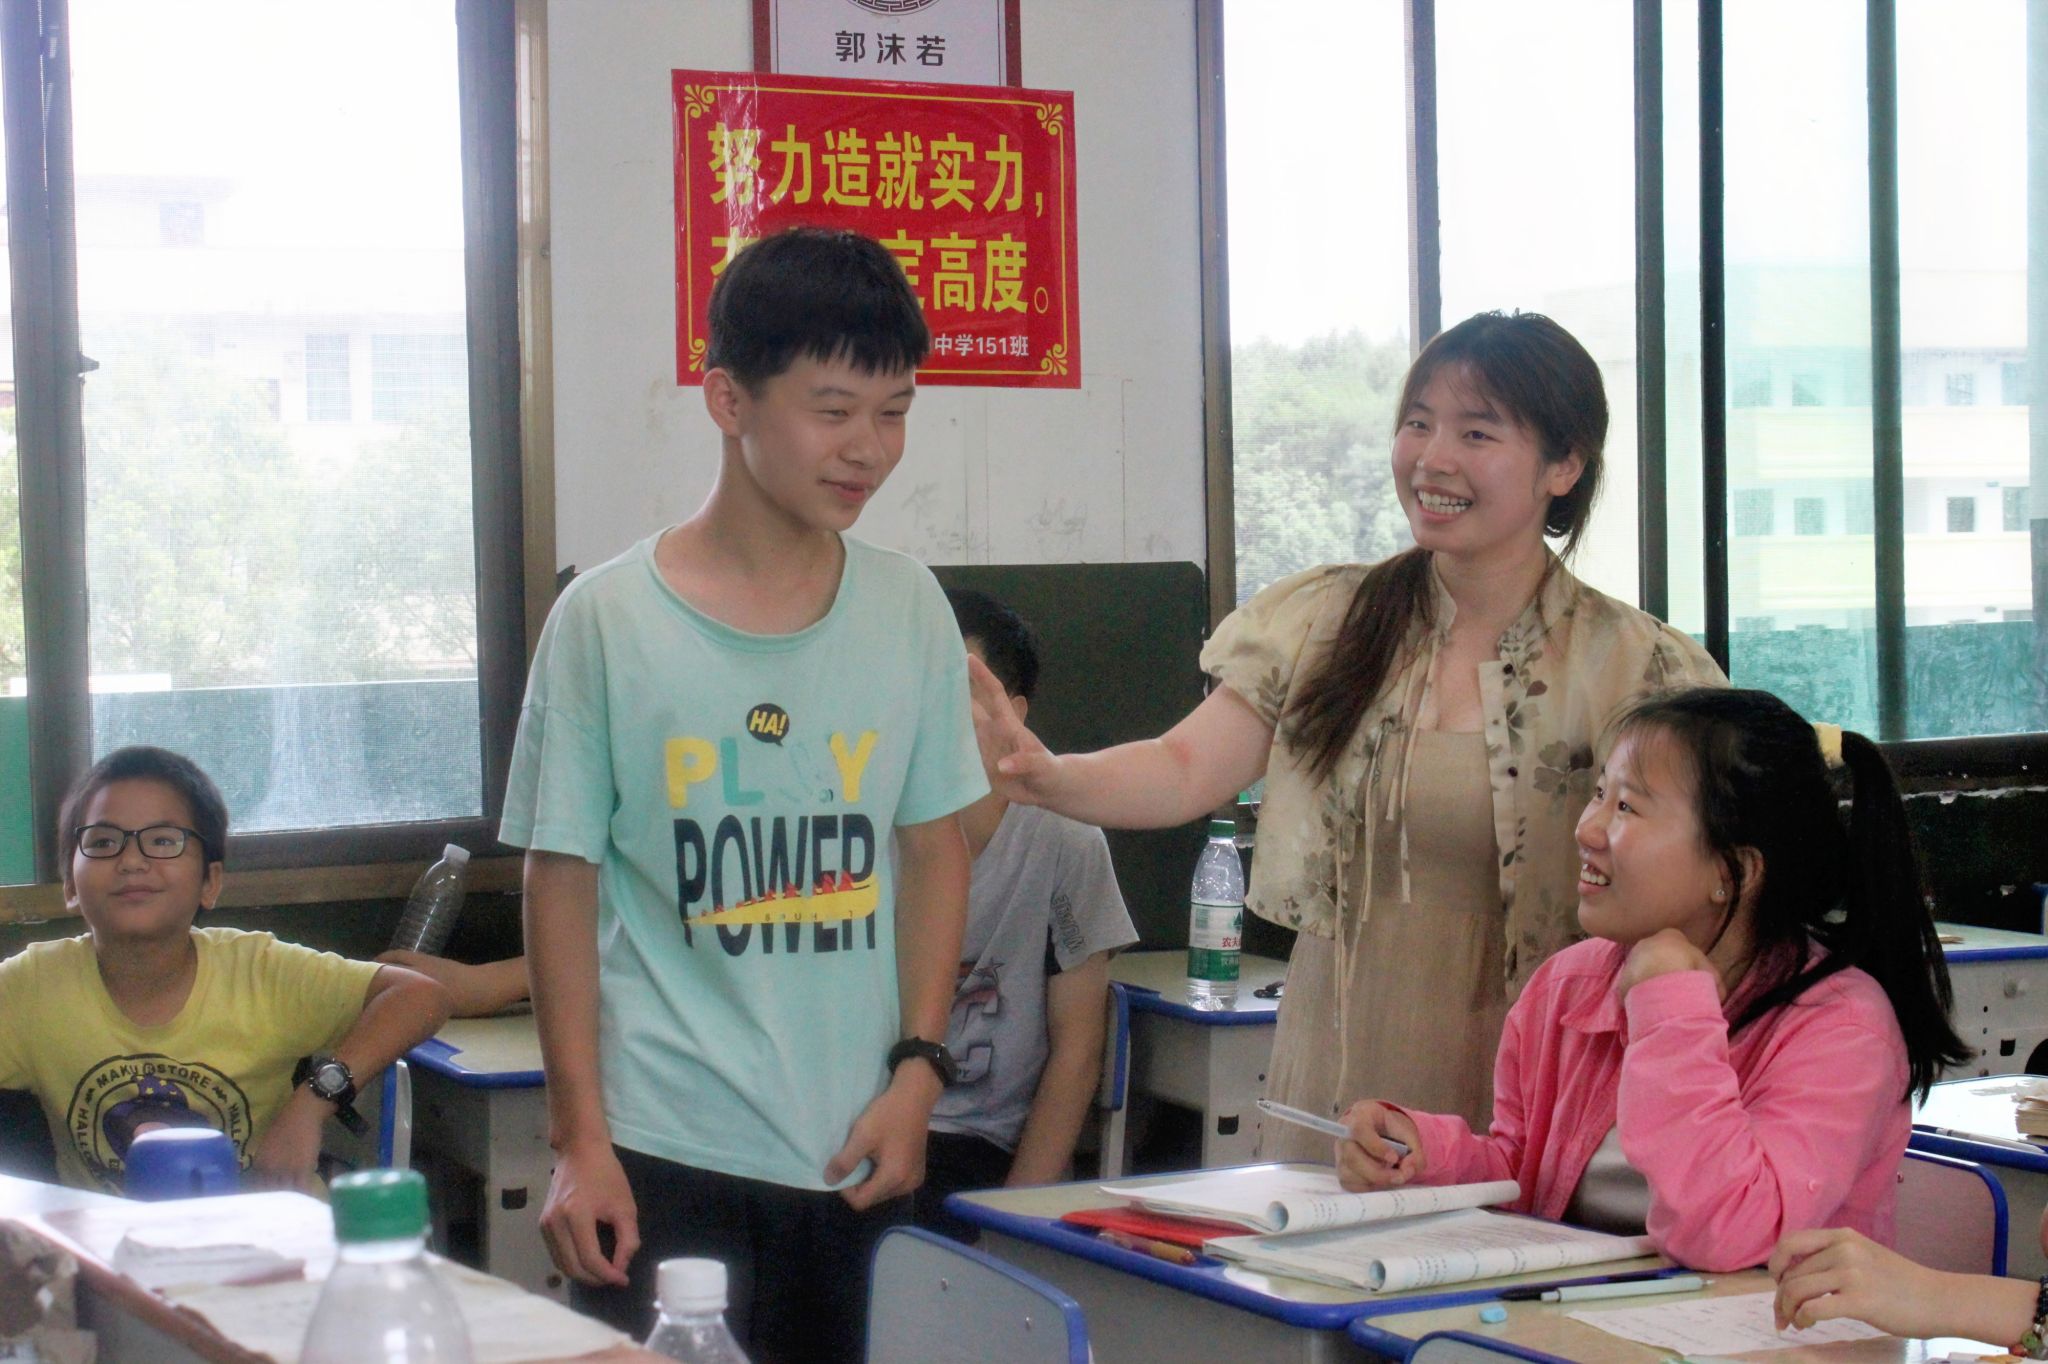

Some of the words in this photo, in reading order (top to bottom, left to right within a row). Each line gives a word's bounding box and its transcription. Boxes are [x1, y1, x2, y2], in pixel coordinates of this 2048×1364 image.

[835, 30, 946, 67] 郭沫若
[934, 333, 1029, 357] 中学151班
[749, 709, 788, 737] HA!
[664, 729, 880, 809] PLY
[673, 813, 877, 957] POWER
[156, 1063, 213, 1089] STORE
